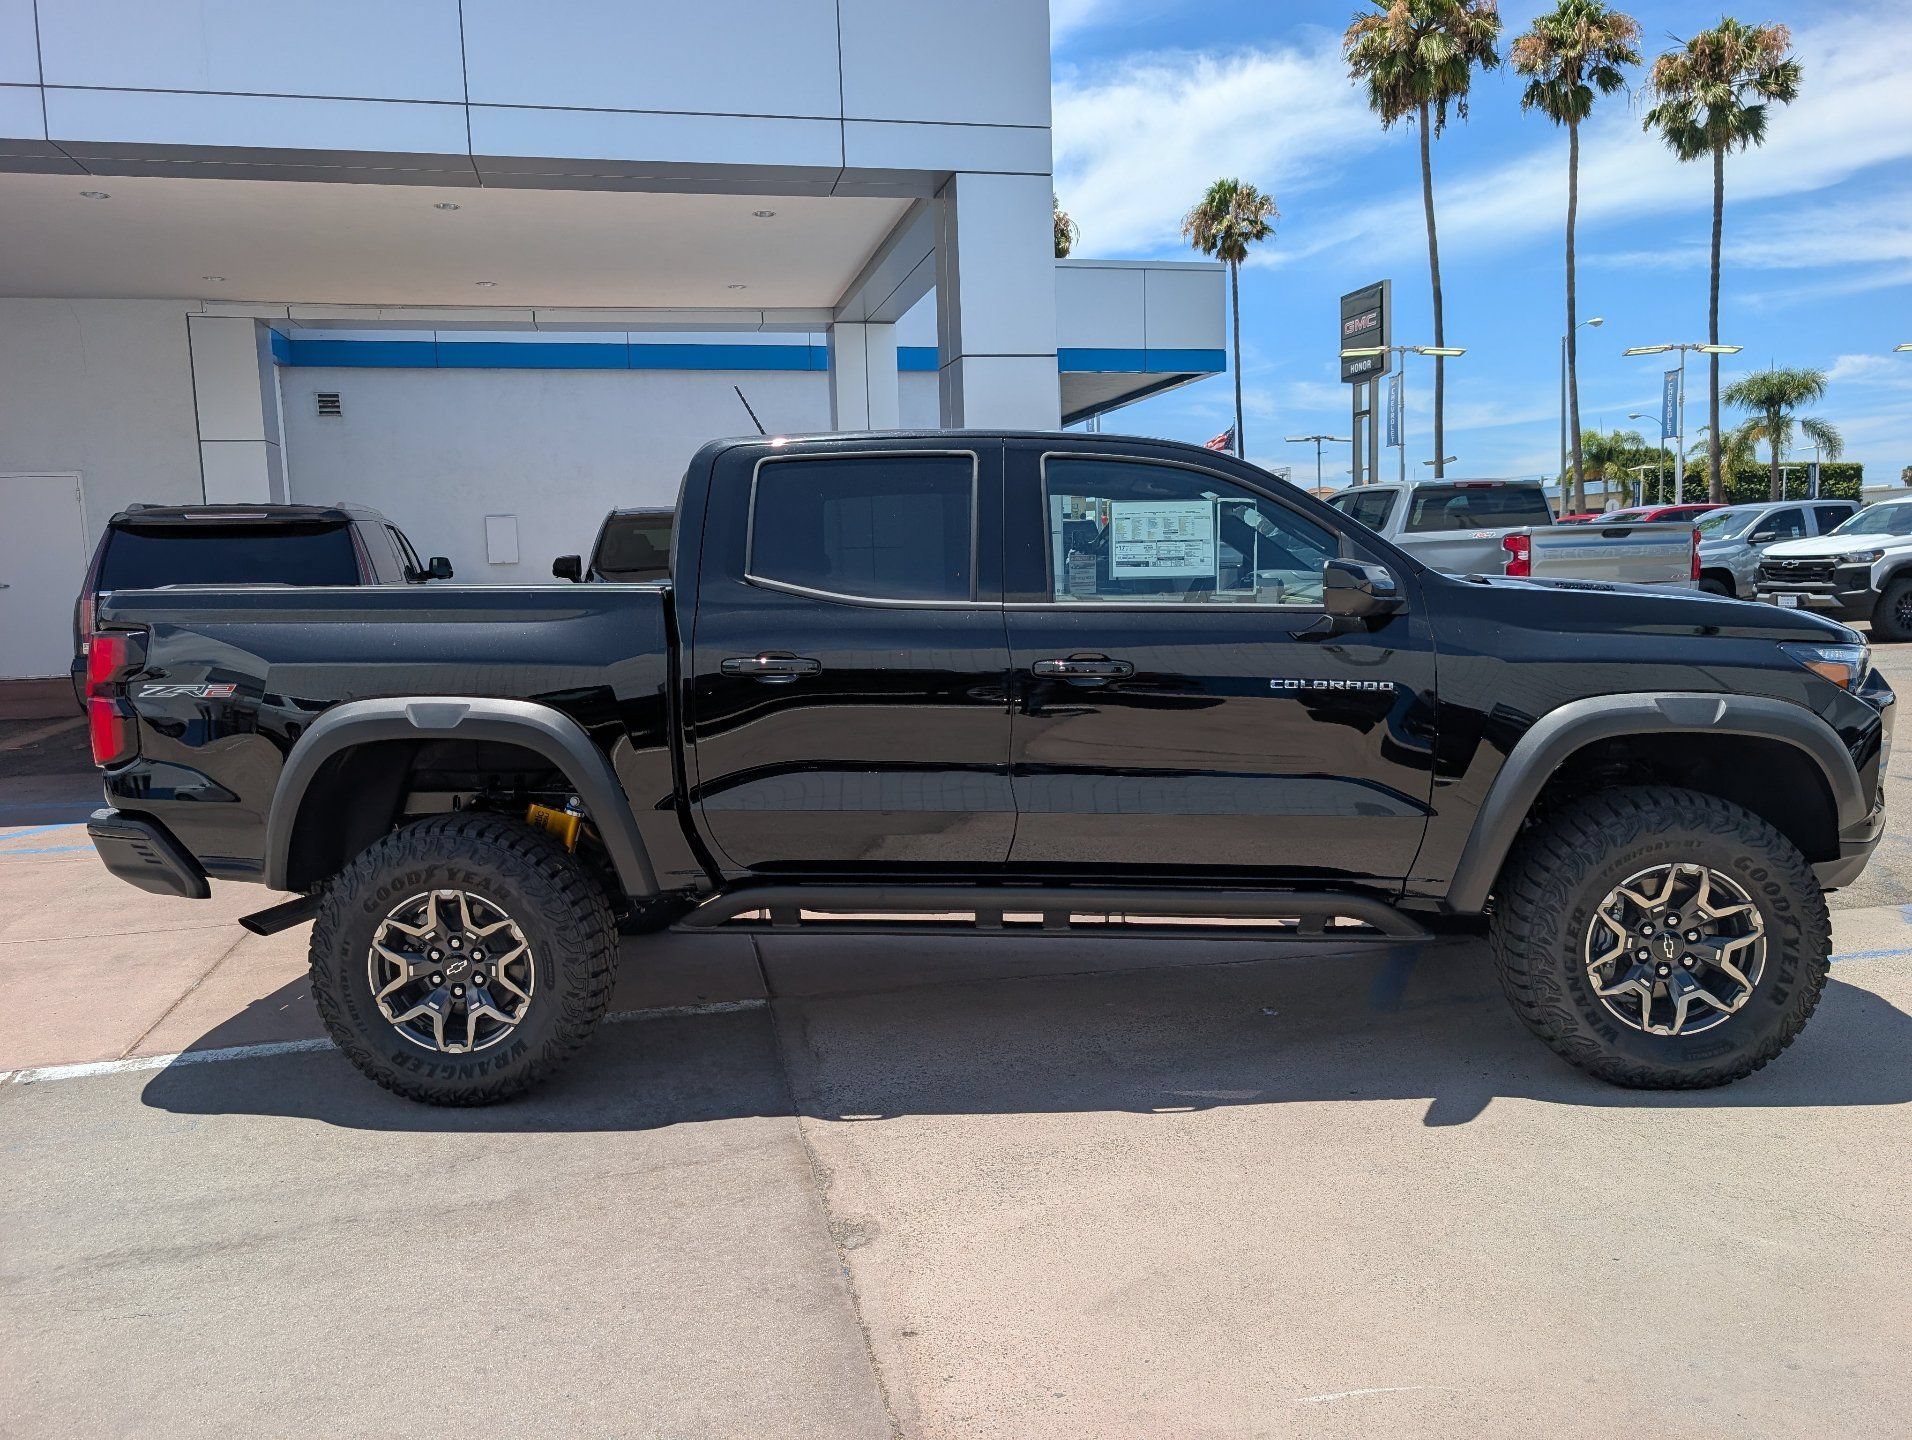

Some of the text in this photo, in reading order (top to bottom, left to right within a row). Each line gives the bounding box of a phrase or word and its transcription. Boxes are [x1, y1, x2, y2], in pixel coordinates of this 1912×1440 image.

[1344, 312, 1377, 335] GMC
[1350, 359, 1372, 374] HONOR
[138, 683, 237, 698] ZR2
[1270, 679, 1394, 691] COLORADO
